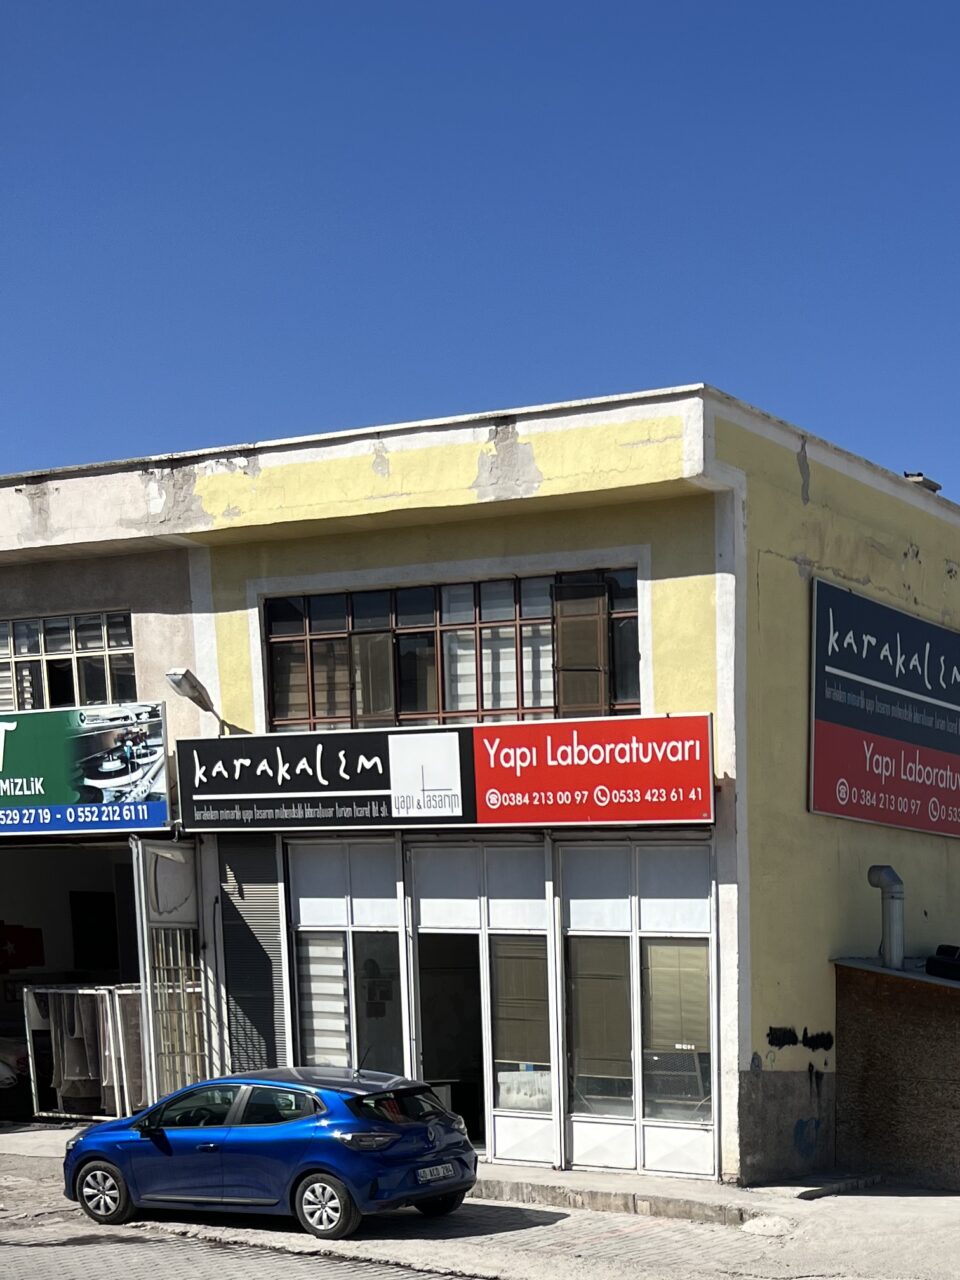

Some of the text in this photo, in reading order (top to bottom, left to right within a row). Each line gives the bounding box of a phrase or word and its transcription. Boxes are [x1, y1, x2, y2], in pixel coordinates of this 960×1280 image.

[483, 730, 700, 777] Yapı Laboratuvarı
[863, 740, 896, 785] Yapı
[502, 790, 589, 806] 0384 213 00 97
[612, 787, 702, 803] 0533 423 61 41
[852, 787, 921, 815] 0 384 213 00 97
[0, 810, 19, 824] 529
[22, 809, 35, 824] 27
[38, 808, 51, 823] 19
[66, 807, 75, 822] 0
[77, 807, 99, 822] 552
[101, 806, 121, 821] 212
[122, 805, 135, 820] 61
[137, 805, 148, 820] 11
[394, 795, 414, 815] yapı
[416, 799, 422, 809] &
[940, 805, 946, 819] 0
